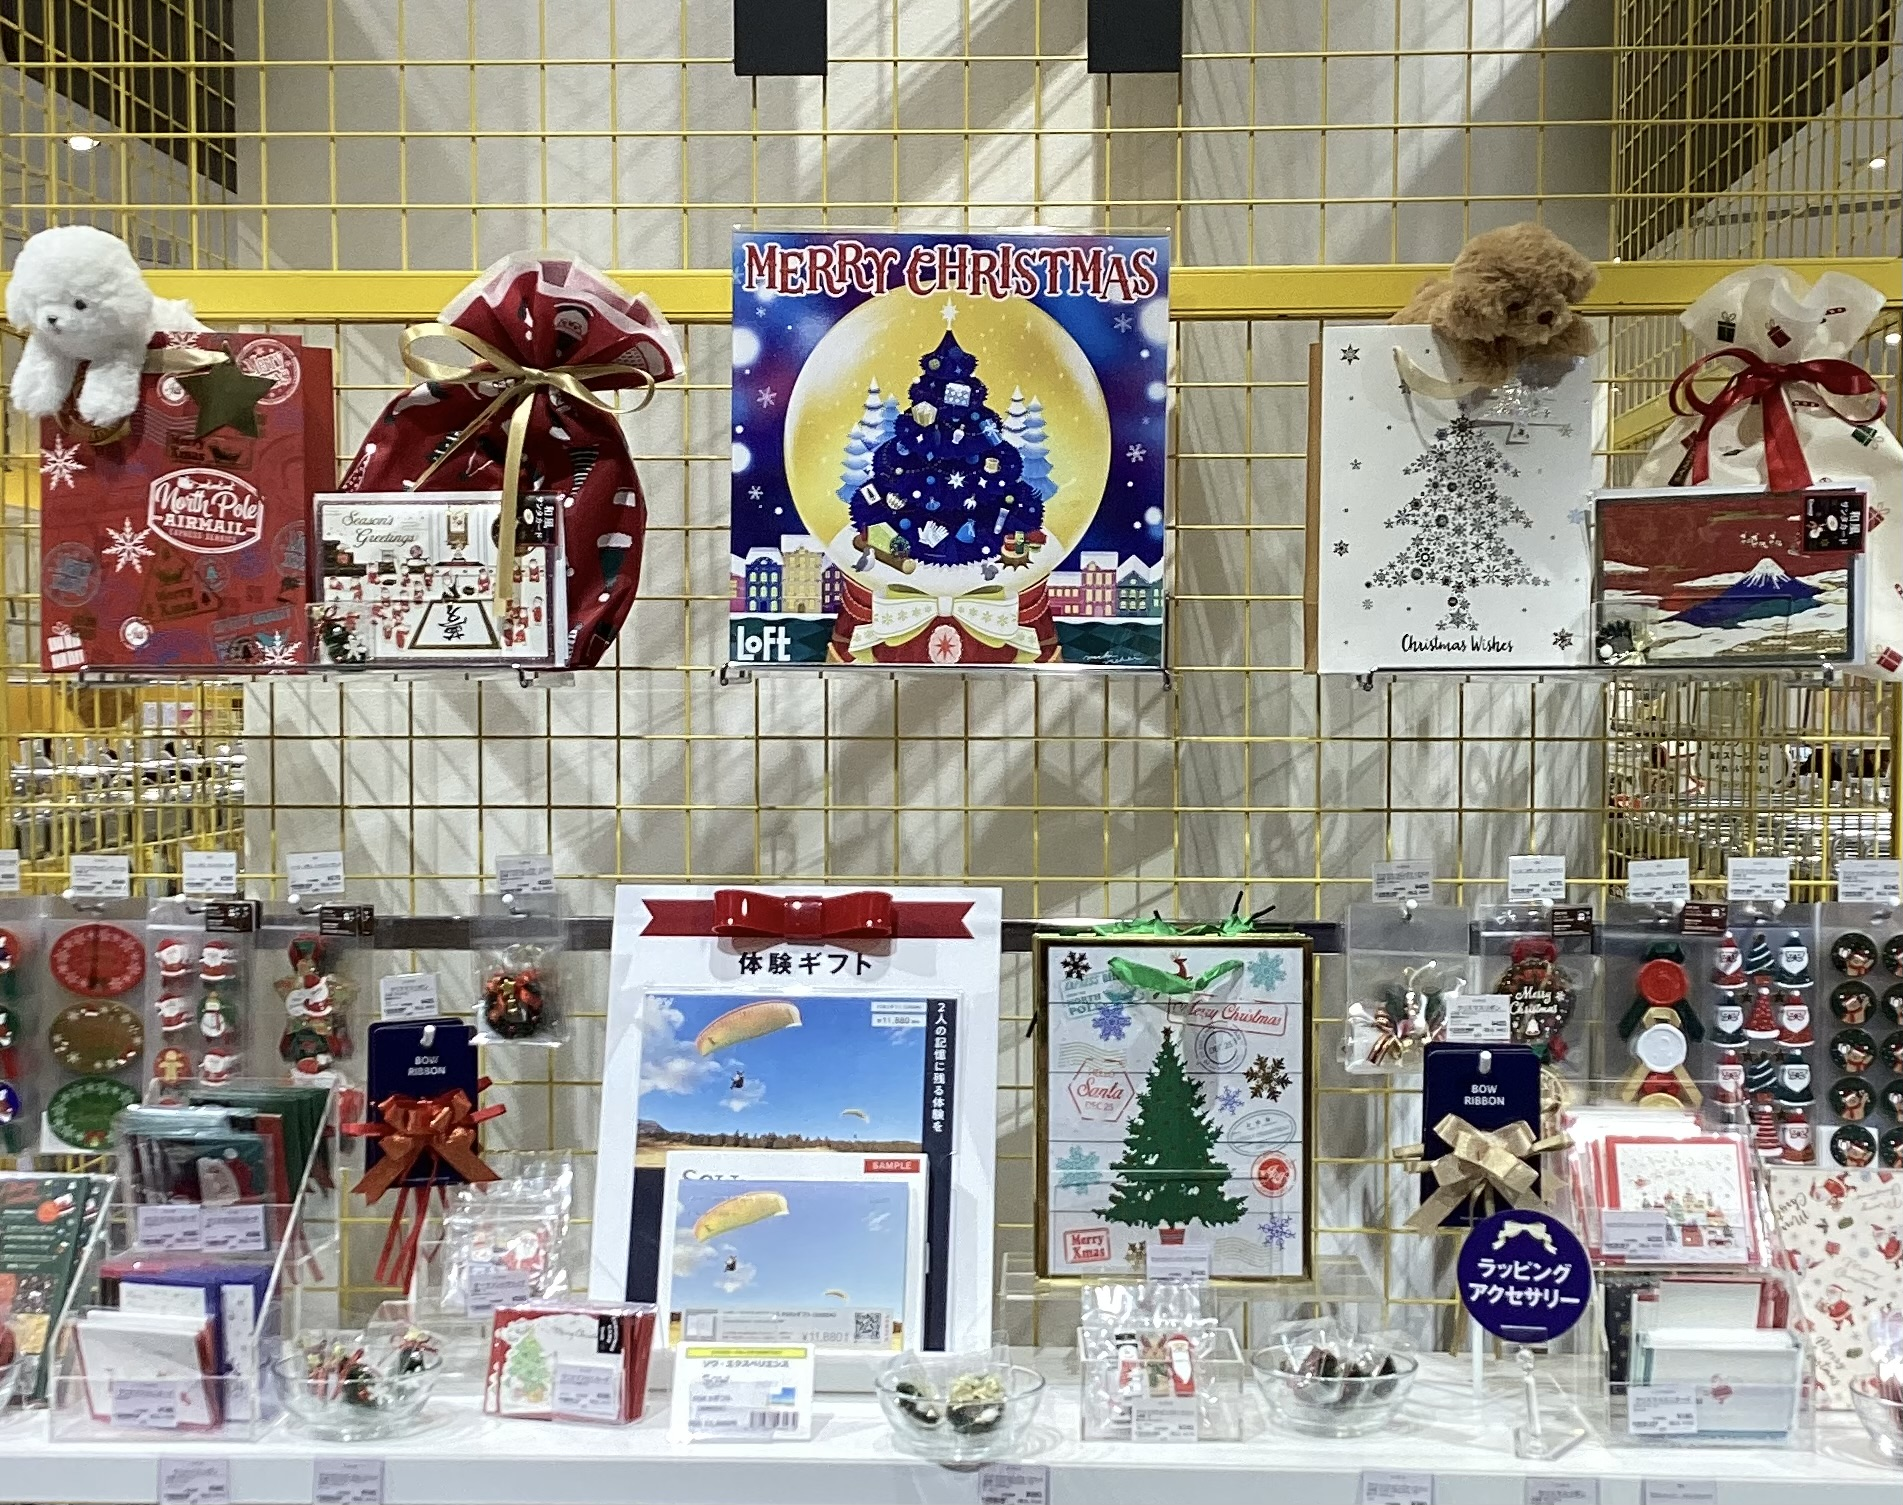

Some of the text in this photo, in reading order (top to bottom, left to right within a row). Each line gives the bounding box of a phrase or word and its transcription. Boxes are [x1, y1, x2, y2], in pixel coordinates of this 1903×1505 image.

[742, 242, 1159, 303] MERRY CHRISTMAS
[155, 482, 259, 520] North Pole
[163, 513, 247, 536] AIRMAIL
[342, 510, 394, 527] Season's
[353, 528, 415, 548] Greetings
[1401, 633, 1514, 653] Christmas Wishes
[738, 951, 872, 976] 体験ギフト
[1515, 986, 1552, 1005] Merry
[1221, 1002, 1282, 1026] Christmas
[414, 1055, 440, 1066] BOW
[931, 1002, 948, 1133] 2人の記憶に残る体験を
[407, 1066, 447, 1077] RIBBON
[1077, 1077, 1124, 1100] Santa
[1470, 1084, 1498, 1094] BOW
[1463, 1095, 1506, 1106] RIBBON
[872, 1160, 913, 1170] SAMPLE
[1071, 1233, 1105, 1246] Merry
[1072, 1246, 1105, 1260] Xmas
[1477, 1258, 1573, 1285] ラッピング
[1468, 1282, 1581, 1309] アクセサリー
